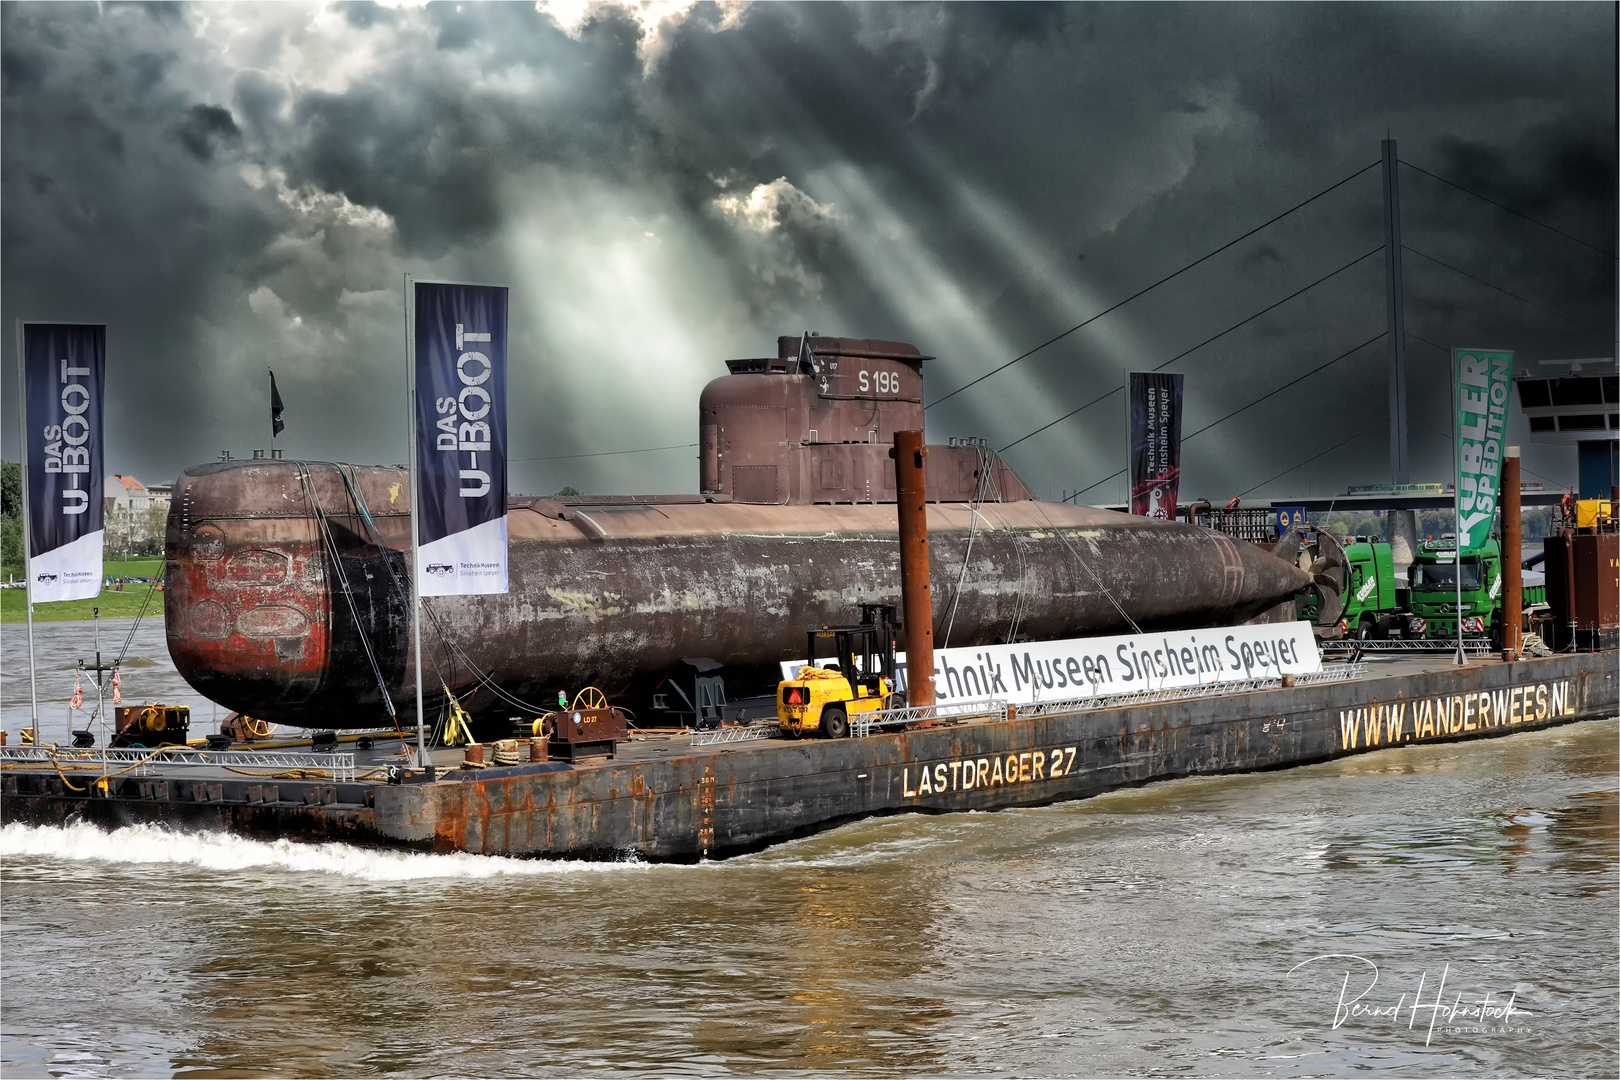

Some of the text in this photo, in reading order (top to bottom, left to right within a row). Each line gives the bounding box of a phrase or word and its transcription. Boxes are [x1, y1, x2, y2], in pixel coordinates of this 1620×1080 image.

[456, 323, 491, 497] U-BOOT
[859, 370, 900, 393] S 196
[44, 424, 62, 473] DAS
[61, 359, 90, 514] U-BOOT
[436, 396, 457, 450] DAS
[1147, 387, 1155, 473] Technik Museen
[1159, 387, 1170, 473] Sinsheim Speyer
[1476, 358, 1509, 513] SPEDITION
[1009, 652, 1113, 692] Museen
[1116, 636, 1223, 682] Sinsheim
[1224, 635, 1298, 678] Speyer
[583, 716, 591, 724] LD
[903, 746, 1077, 798] LASTDRAGER 27
